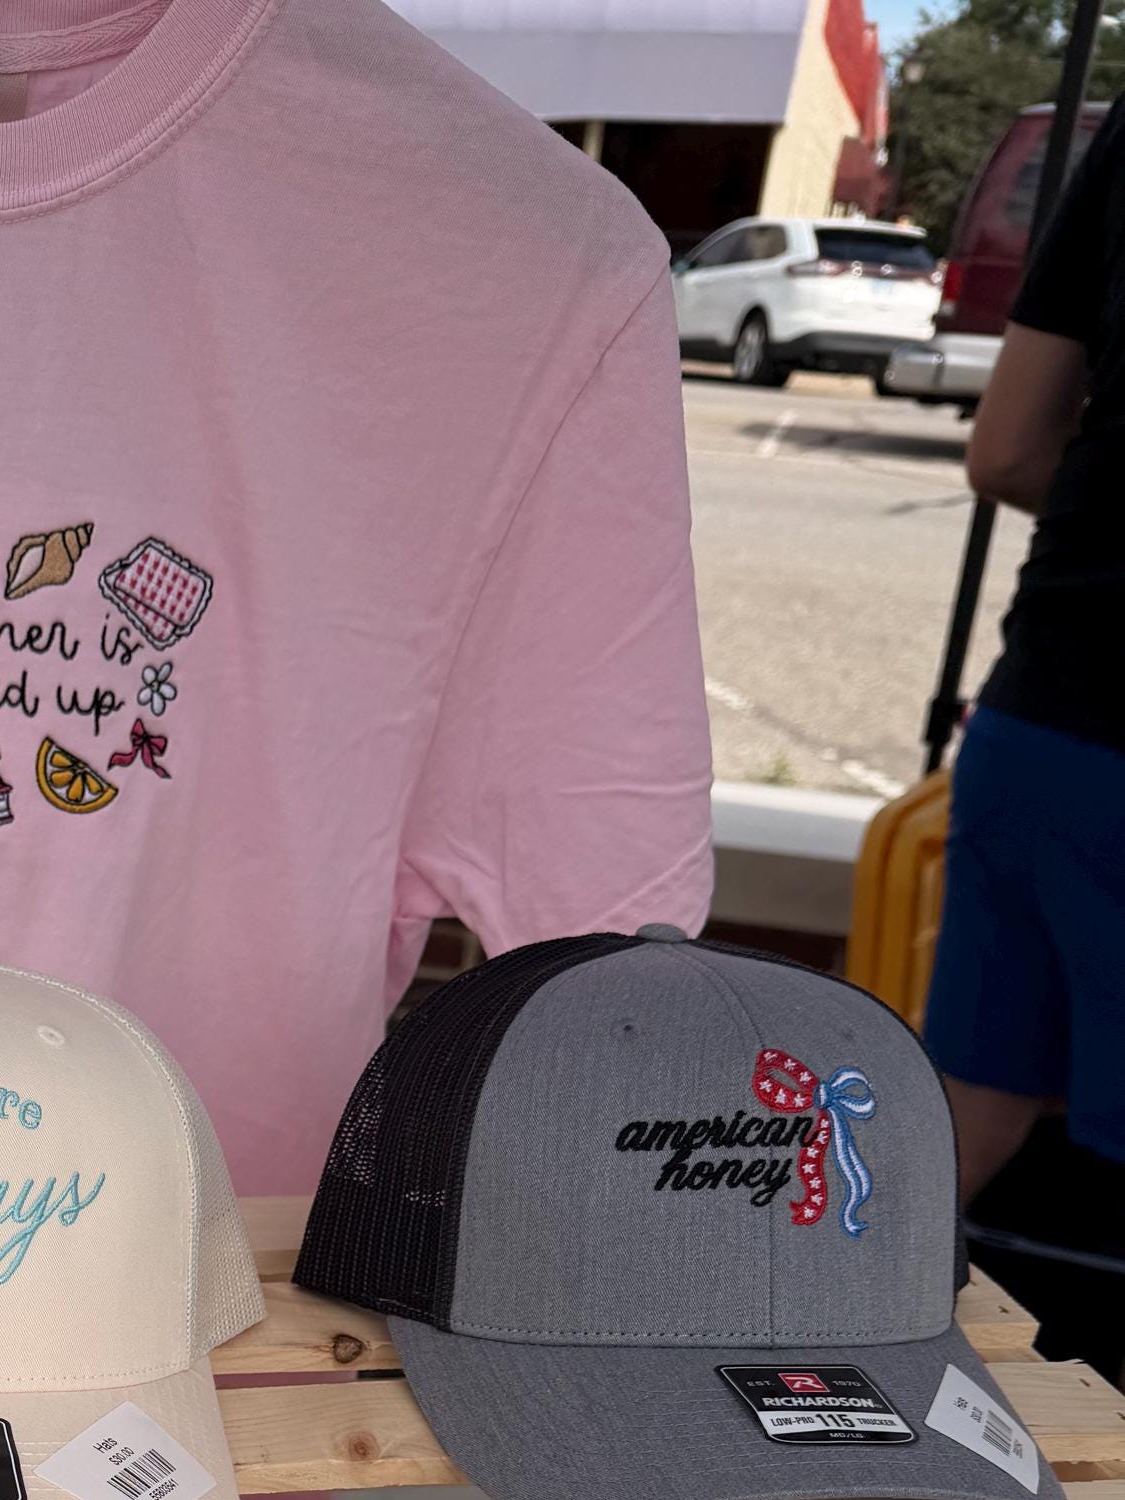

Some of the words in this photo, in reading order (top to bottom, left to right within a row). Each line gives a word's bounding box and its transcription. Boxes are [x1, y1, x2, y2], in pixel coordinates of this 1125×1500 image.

[100, 614, 143, 665] is
[57, 686, 124, 737] up
[614, 1110, 820, 1152] american
[653, 1149, 793, 1208] honey
[762, 1397, 875, 1409] RICHARDSON
[770, 1416, 815, 1427] LOW-PRO
[815, 1413, 856, 1428] 115
[856, 1417, 898, 1427] TRUCKER
[92, 1437, 118, 1454] Hats
[108, 1446, 135, 1466] $30.00
